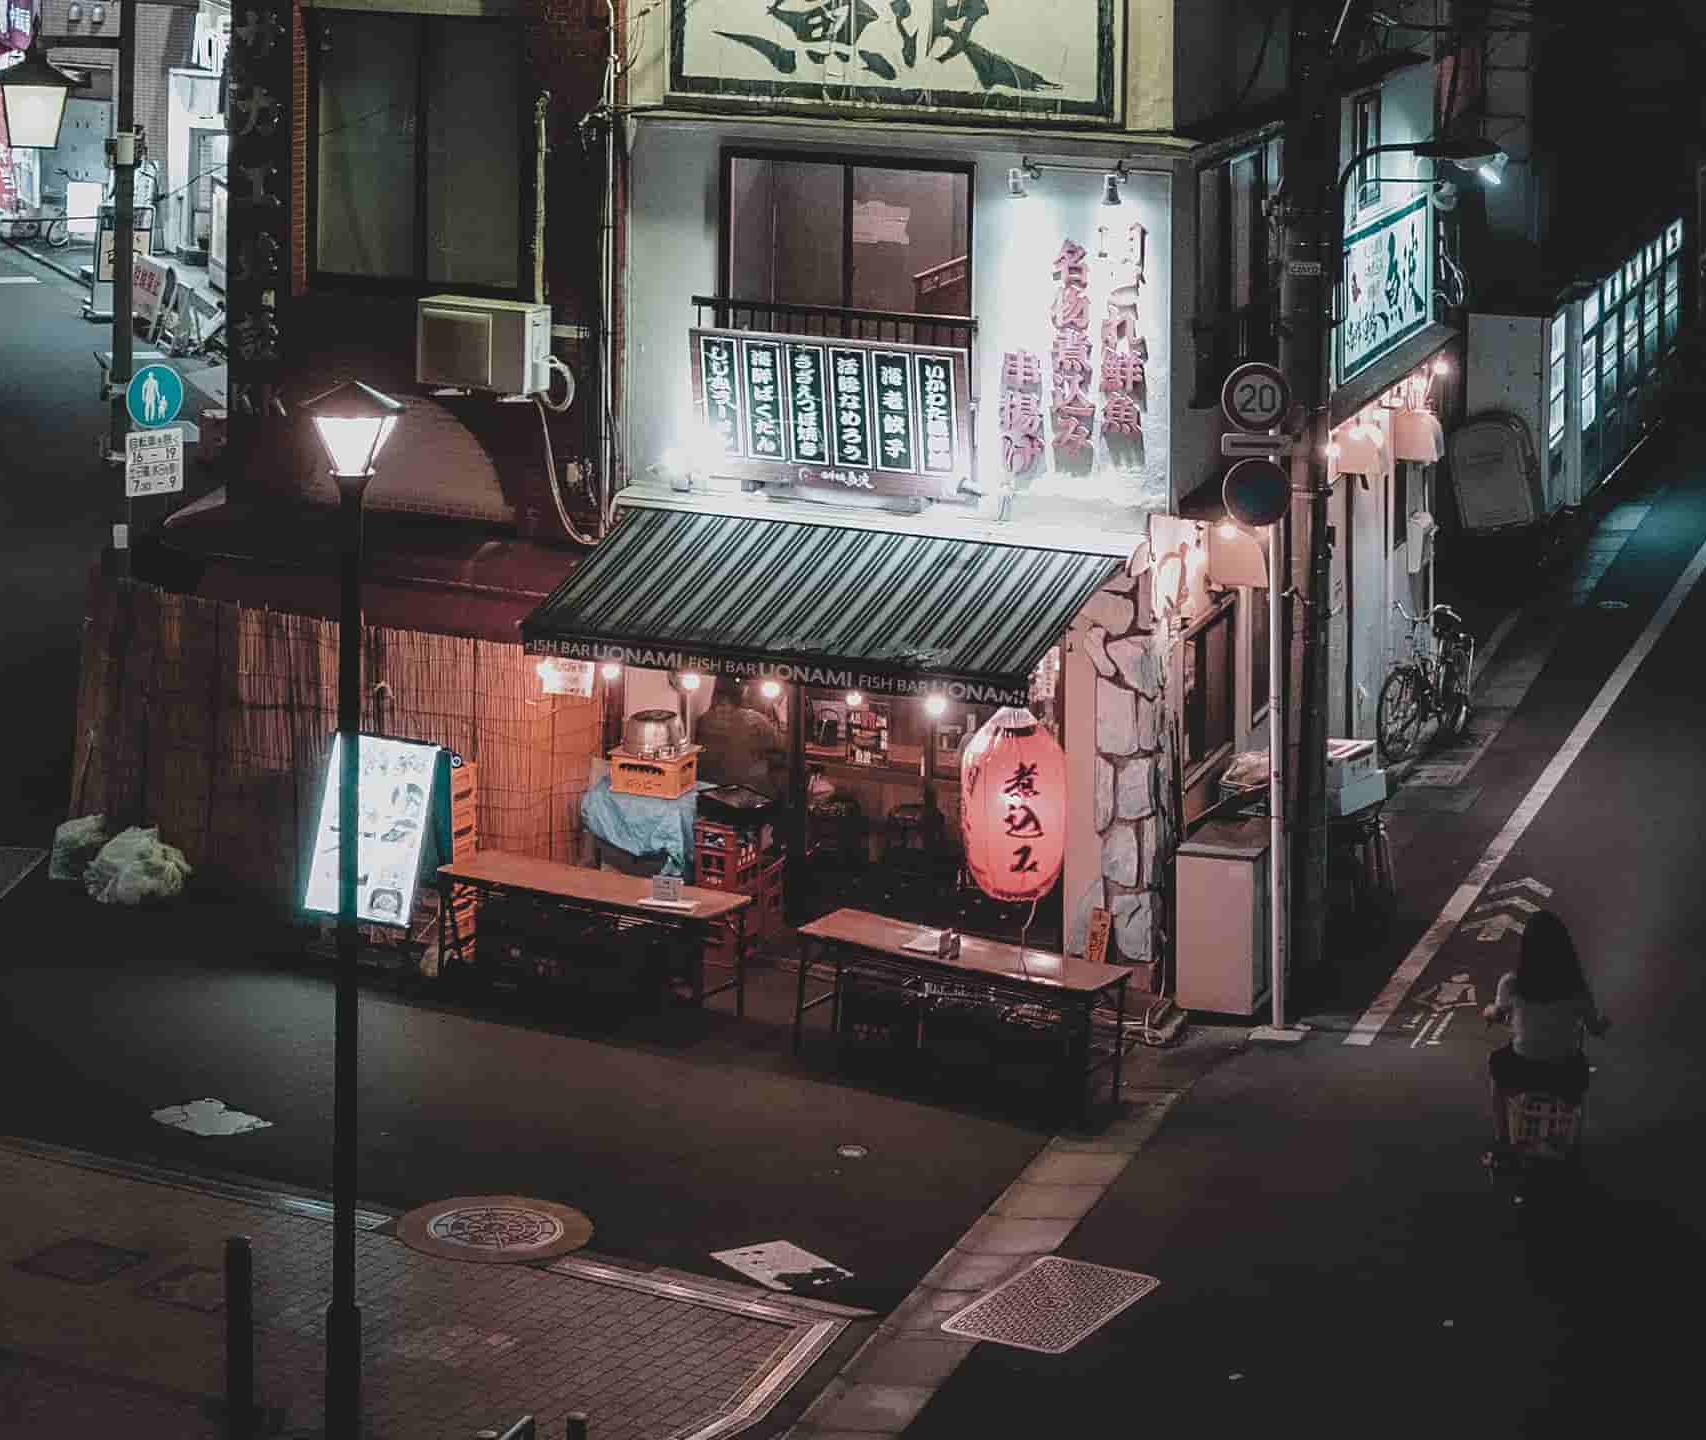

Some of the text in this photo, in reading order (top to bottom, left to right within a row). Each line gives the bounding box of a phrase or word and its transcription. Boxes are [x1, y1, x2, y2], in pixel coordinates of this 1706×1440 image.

[1238, 382, 1278, 414] 20
[561, 642, 590, 657] BAR
[689, 657, 722, 672] FISH
[725, 660, 757, 675] BAR
[757, 662, 853, 688] UONAMI
[858, 674, 894, 693] FISH
[896, 679, 926, 694] BAR
